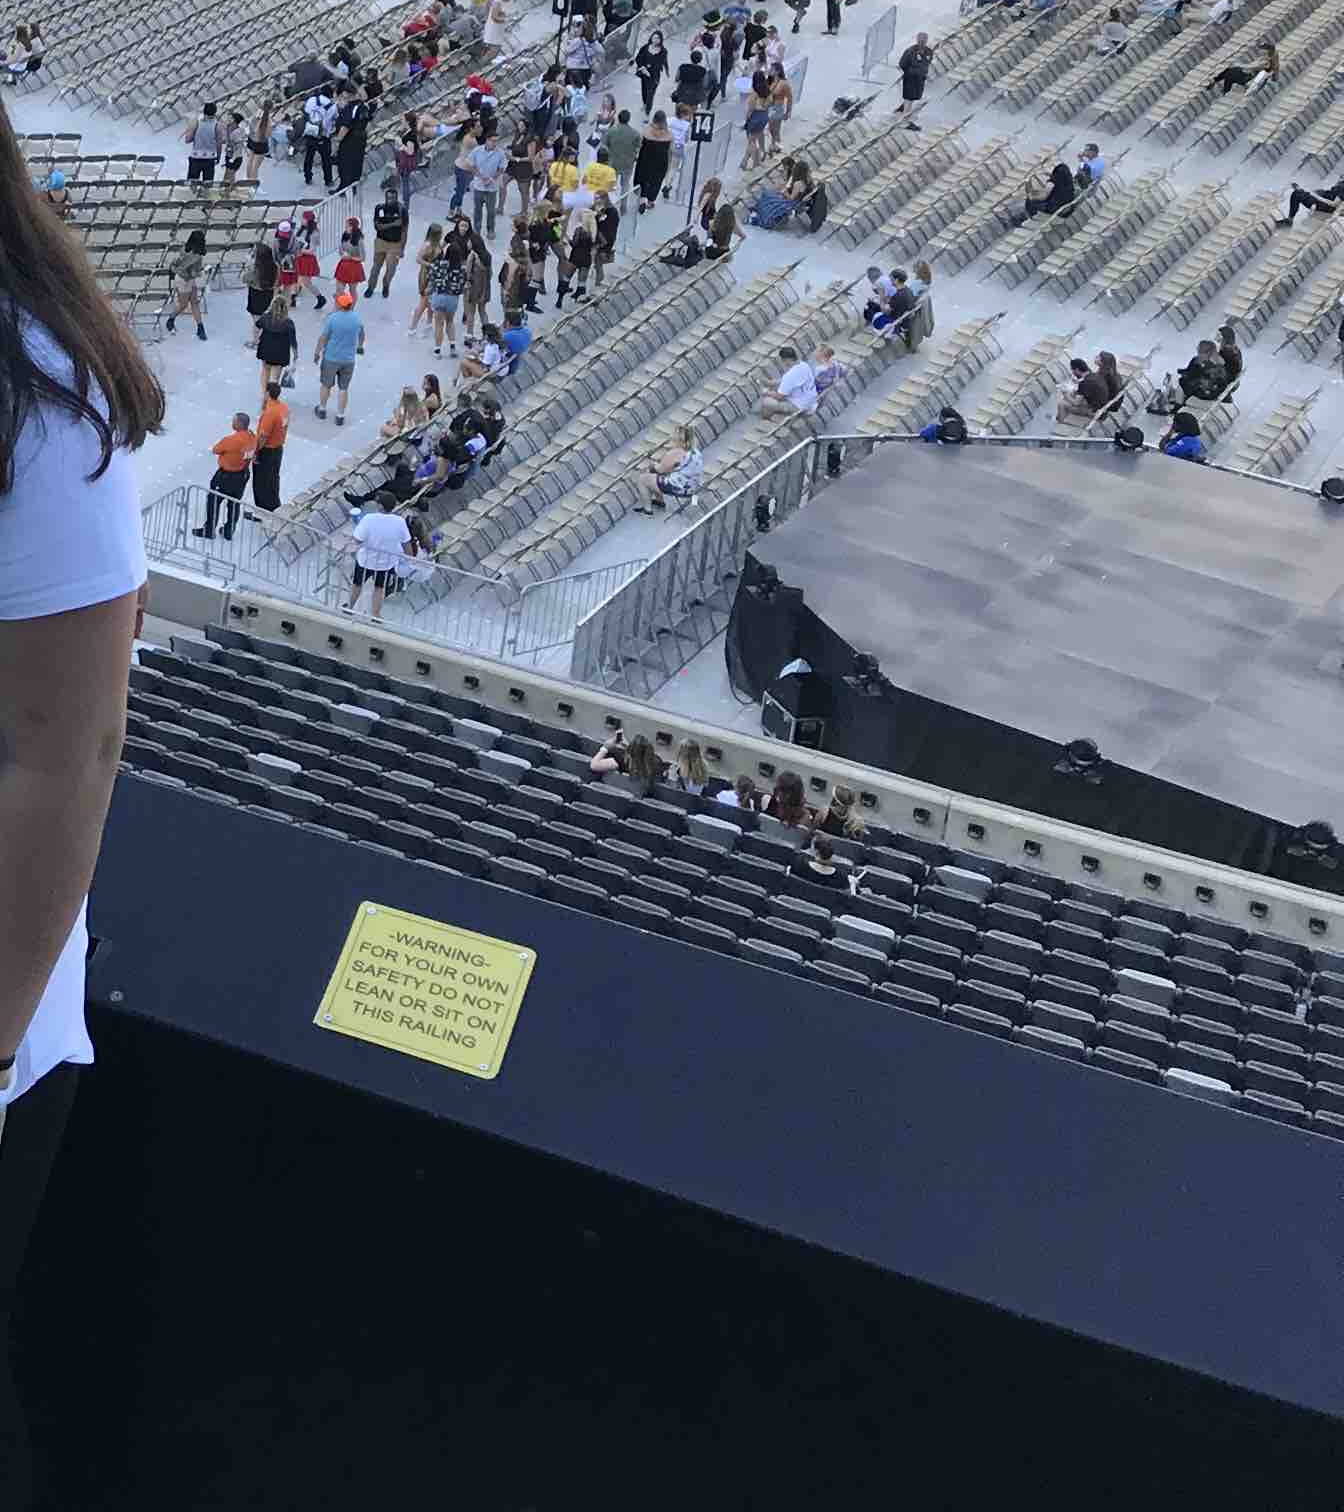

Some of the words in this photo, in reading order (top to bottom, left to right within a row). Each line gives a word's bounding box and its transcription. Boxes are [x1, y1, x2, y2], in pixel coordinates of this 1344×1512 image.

[694, 114, 712, 135] 14
[351, 959, 426, 989] SAFETY
[428, 981, 459, 1002] DO
[462, 991, 505, 1016] NOT
[359, 941, 400, 964] FOR
[403, 956, 458, 981] YOUR
[462, 971, 511, 997] OWN
[344, 978, 395, 1003] LEAN
[399, 995, 428, 1015] OR
[431, 1004, 465, 1025] SIT
[467, 1015, 498, 1035] ON
[352, 1000, 395, 1025] THIS
[398, 1015, 478, 1049] RAILING
